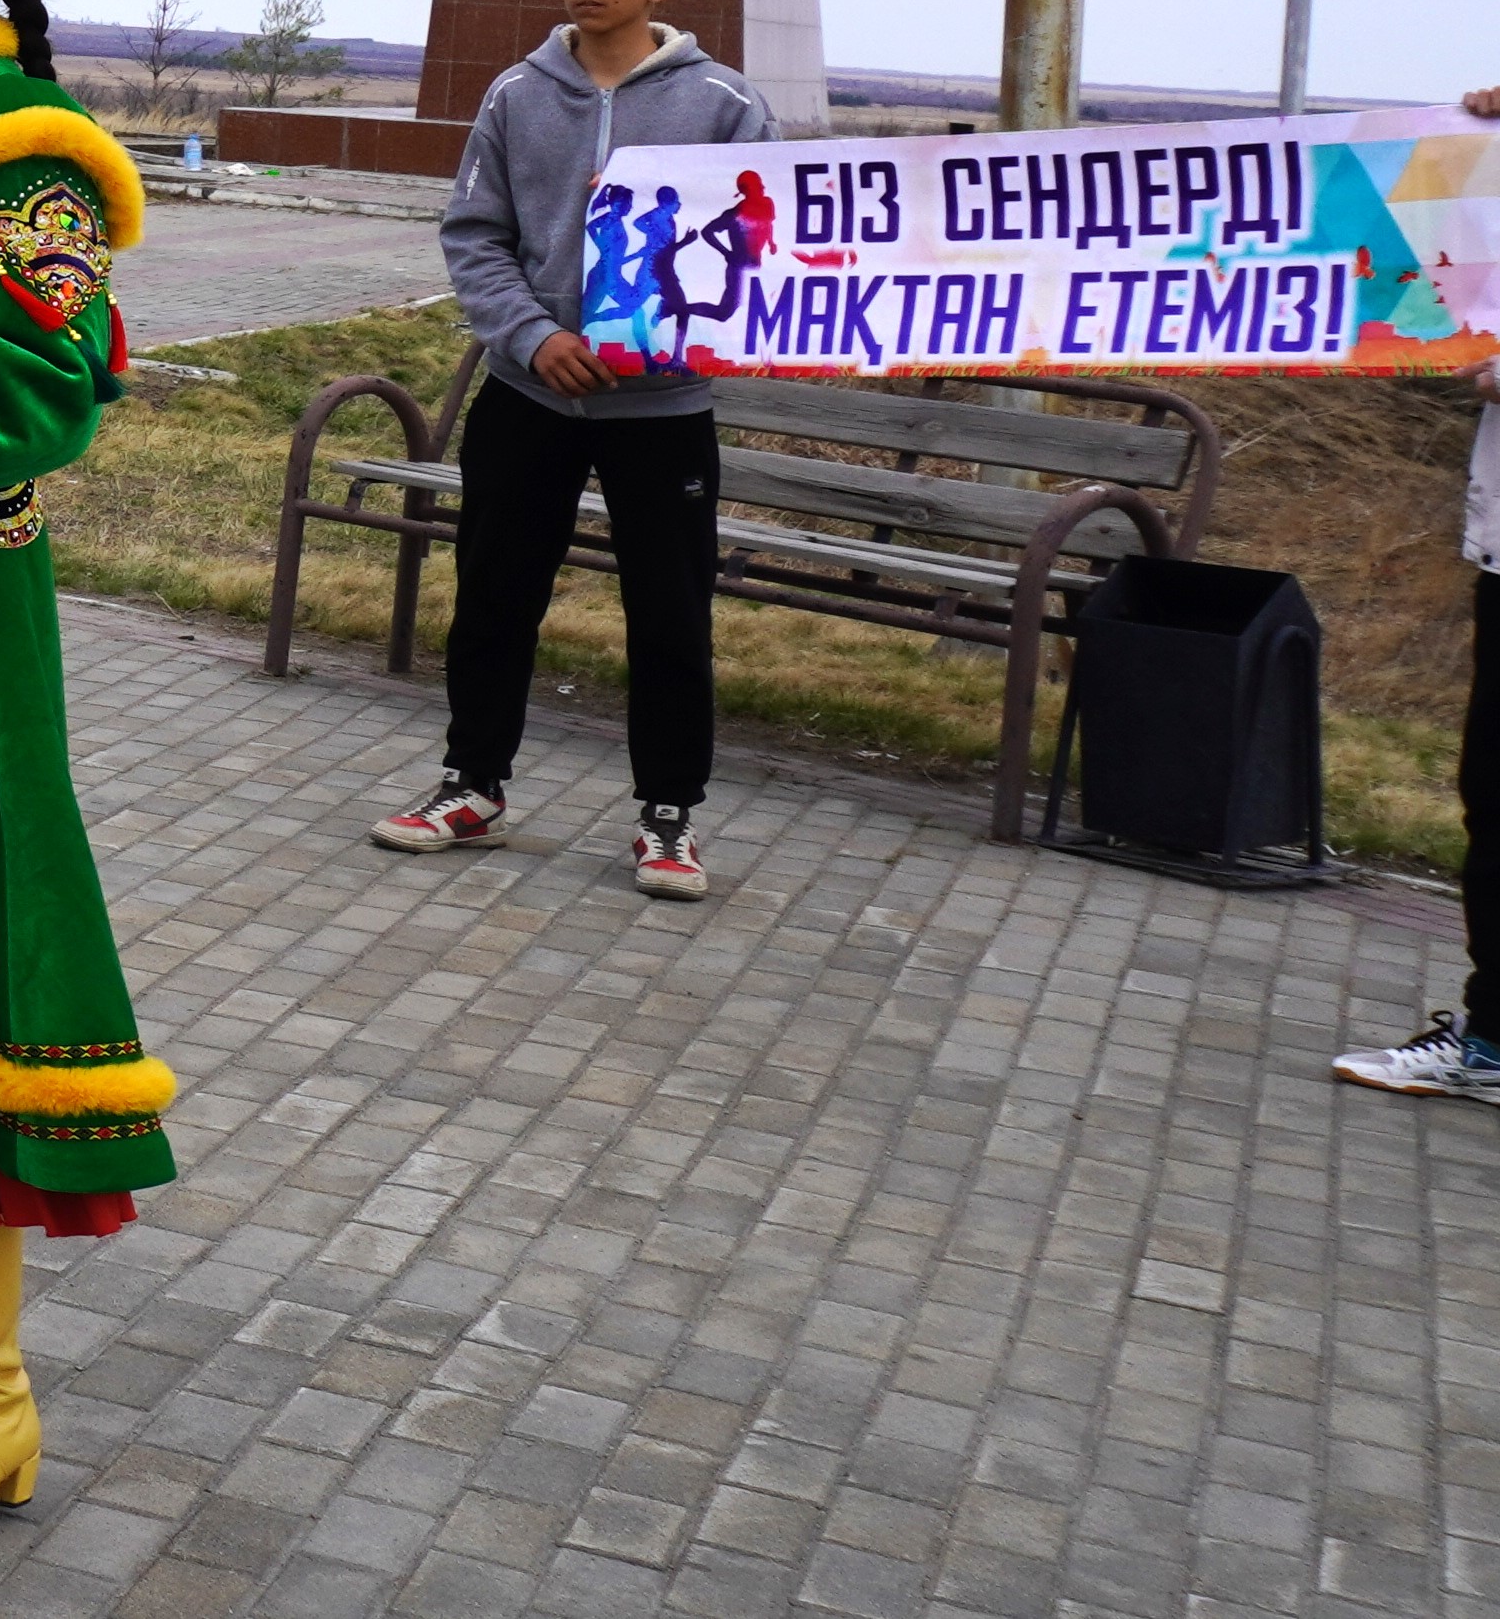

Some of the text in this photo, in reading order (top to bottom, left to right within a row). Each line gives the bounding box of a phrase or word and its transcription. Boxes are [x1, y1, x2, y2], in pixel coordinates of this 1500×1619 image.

[794, 141, 1302, 249] БІЗ СЕНДЕРДІ
[744, 264, 1347, 366] МАҚТАН ЕТЕМІЗ!
